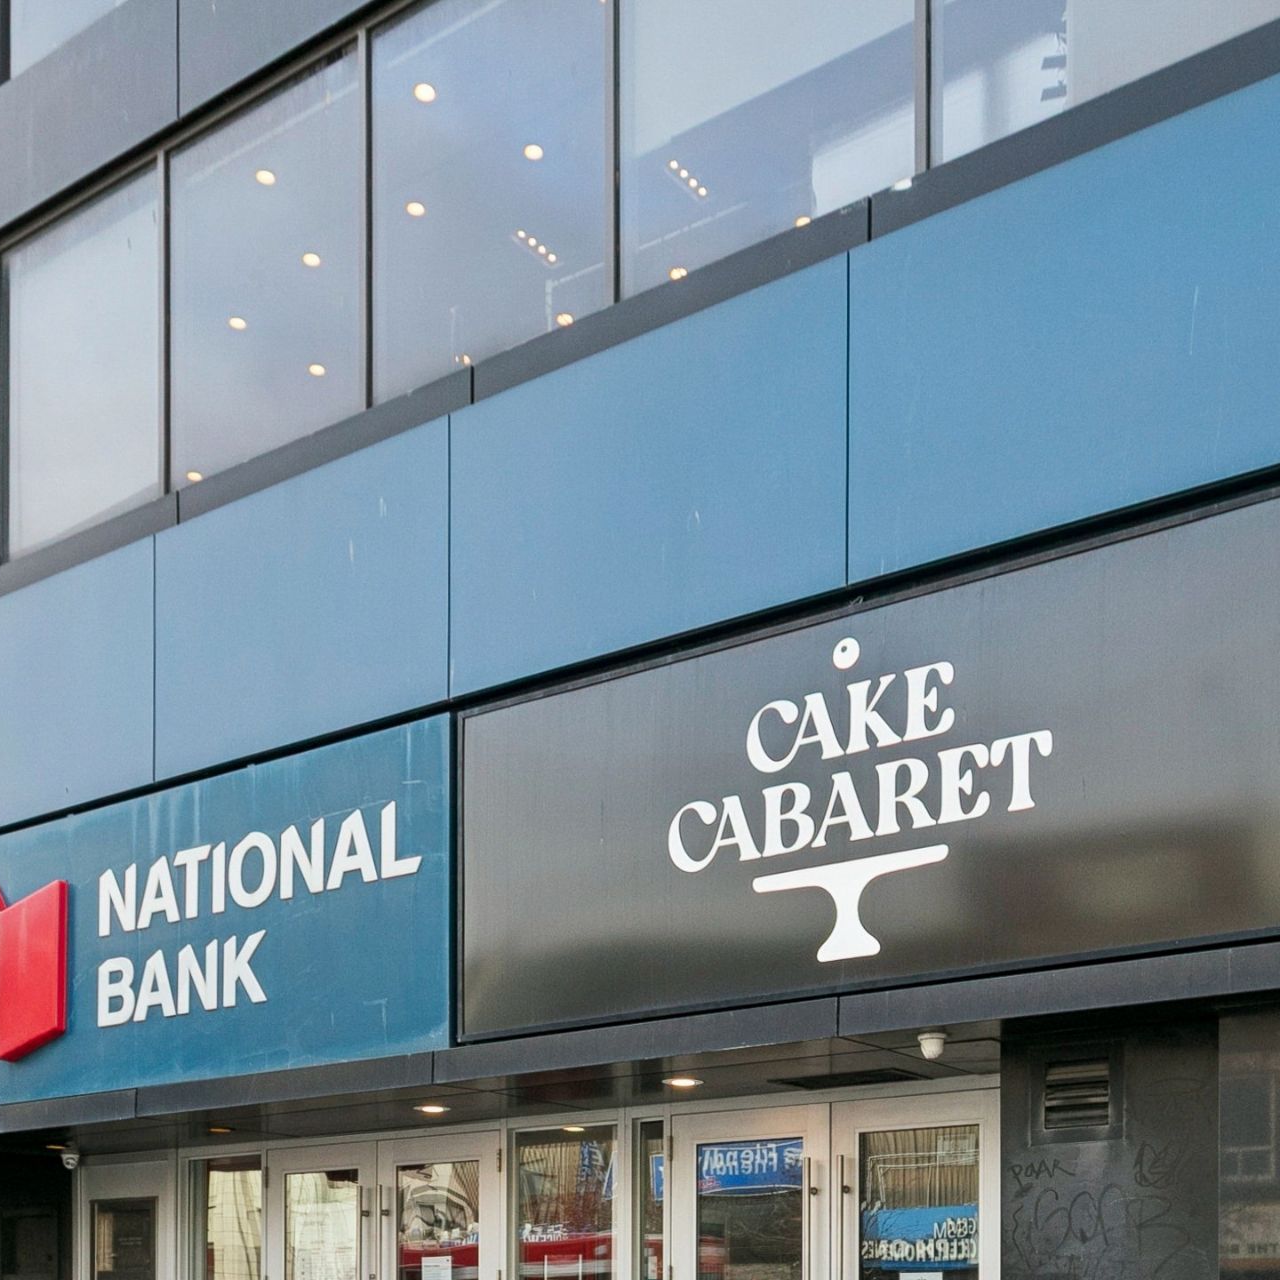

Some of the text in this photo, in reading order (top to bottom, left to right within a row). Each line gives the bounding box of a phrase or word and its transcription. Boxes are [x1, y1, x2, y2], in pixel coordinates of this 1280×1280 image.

[746, 661, 955, 773] CAKE
[668, 729, 1053, 873] CABARET
[98, 800, 422, 936] NATIONAL
[97, 929, 267, 1028] BANK
